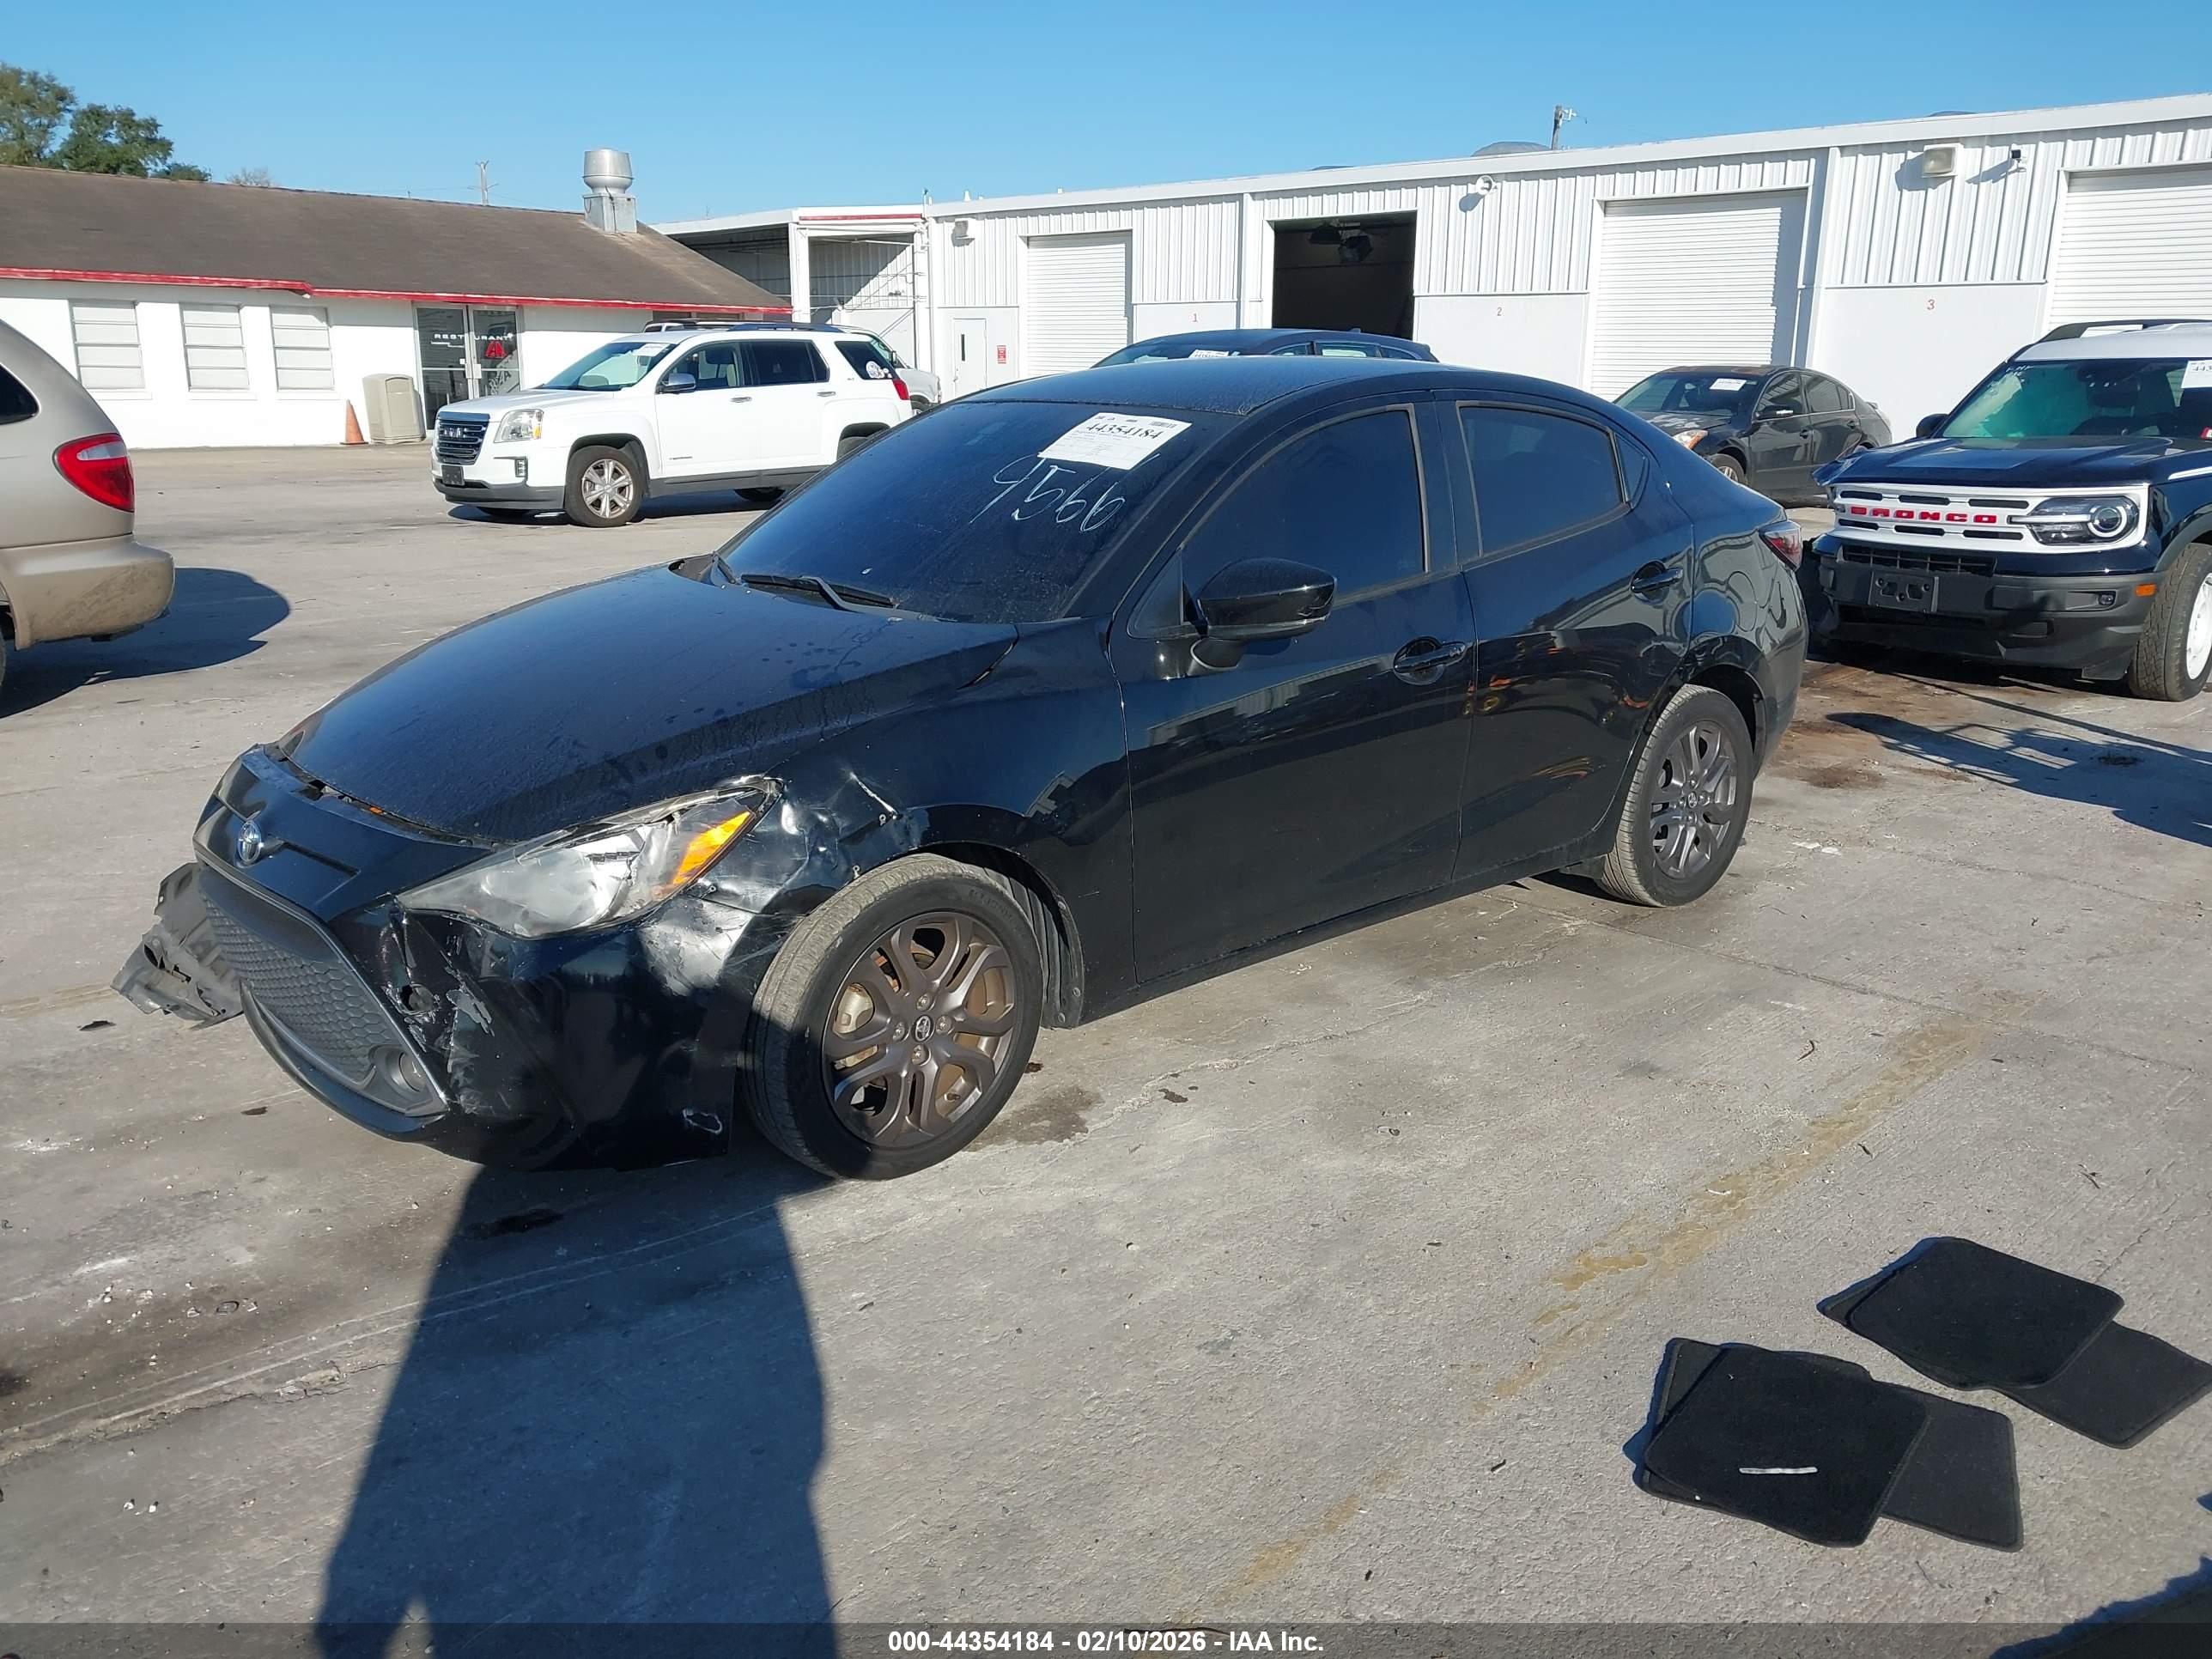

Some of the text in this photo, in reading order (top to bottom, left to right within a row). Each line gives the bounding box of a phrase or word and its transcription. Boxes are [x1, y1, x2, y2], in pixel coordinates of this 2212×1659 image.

[1497, 307, 1503, 316] 2
[1927, 299, 1935, 310] 3
[1192, 313, 1199, 323] 1
[1086, 422, 1164, 440] 44354184
[969, 453, 1160, 533] 9566
[1850, 505, 1998, 525] BRONCO
